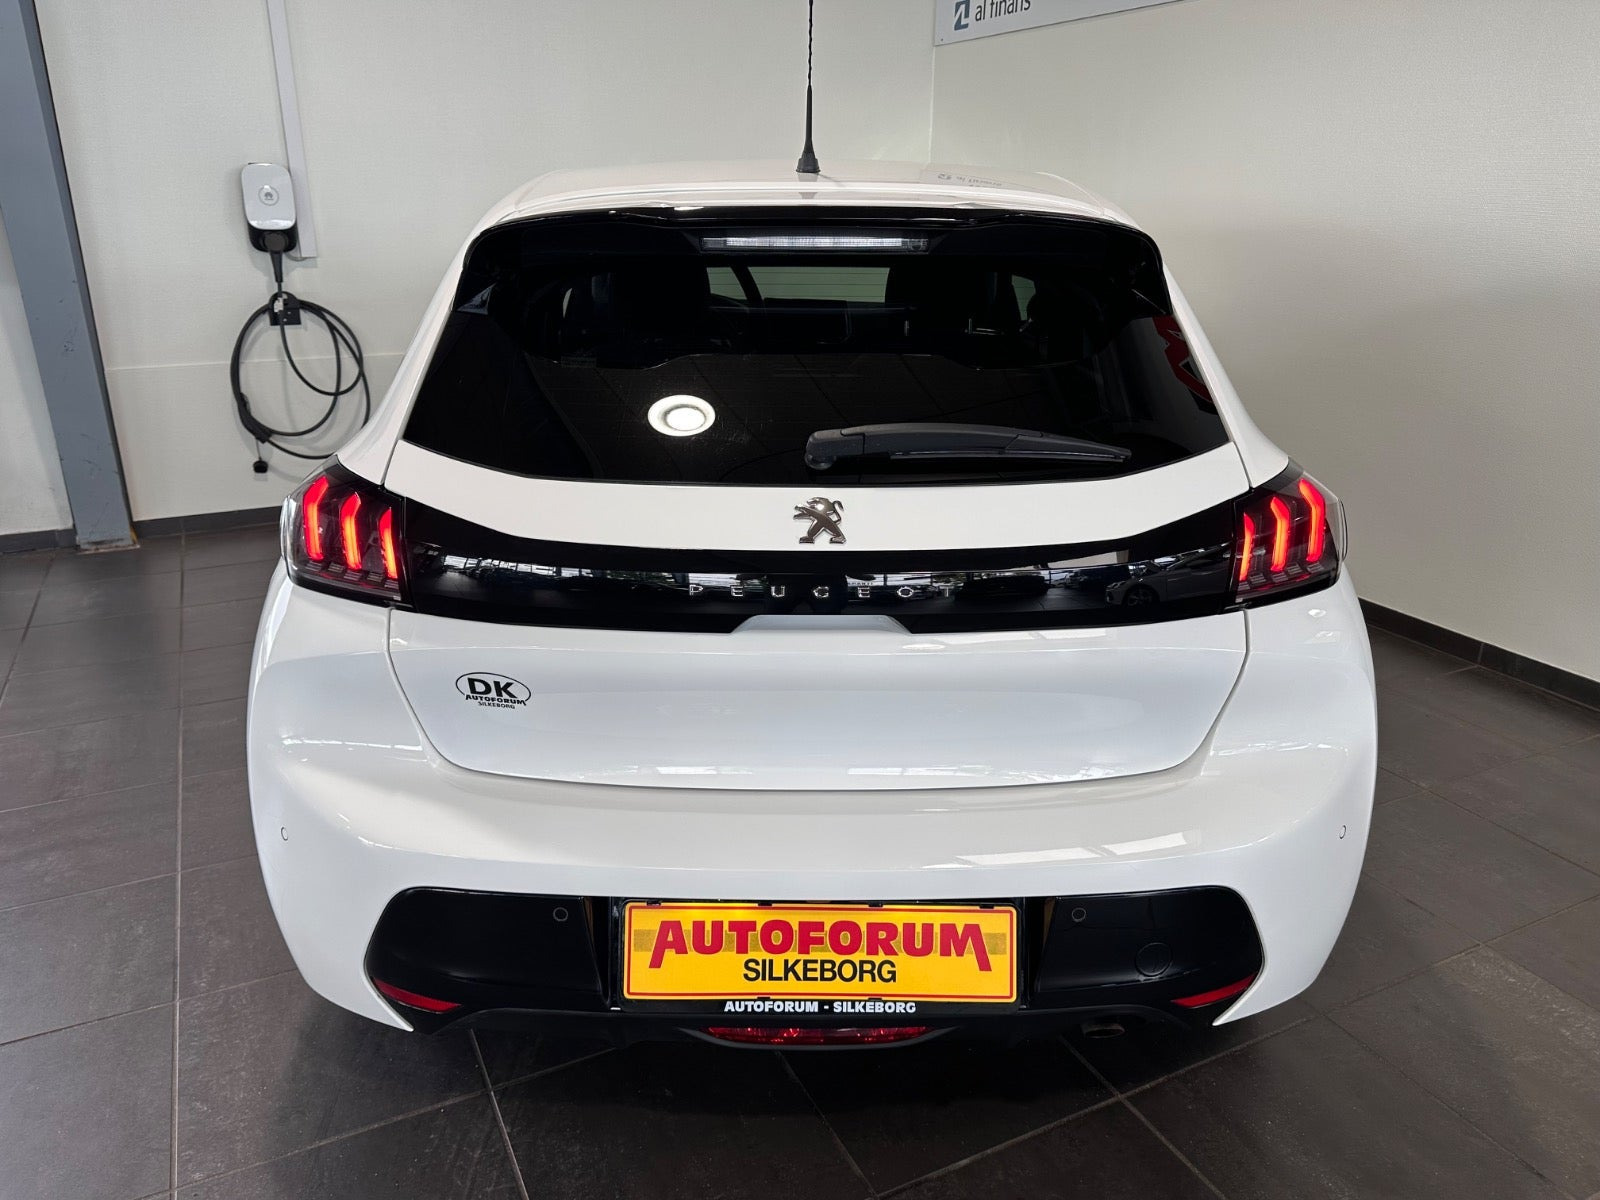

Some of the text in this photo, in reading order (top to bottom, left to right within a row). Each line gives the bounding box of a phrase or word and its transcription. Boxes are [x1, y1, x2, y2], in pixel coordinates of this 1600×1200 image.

[688, 584, 954, 598] PEUGEOT
[467, 677, 518, 699] DK
[465, 694, 527, 706] AUTOFORUM
[477, 701, 516, 709] SILKEBORG
[648, 919, 993, 972] AUTOFORUM
[742, 958, 897, 983] SILKEBORG
[723, 1001, 819, 1013] AUTOFORUM
[833, 1001, 916, 1014] SILKEBORG
